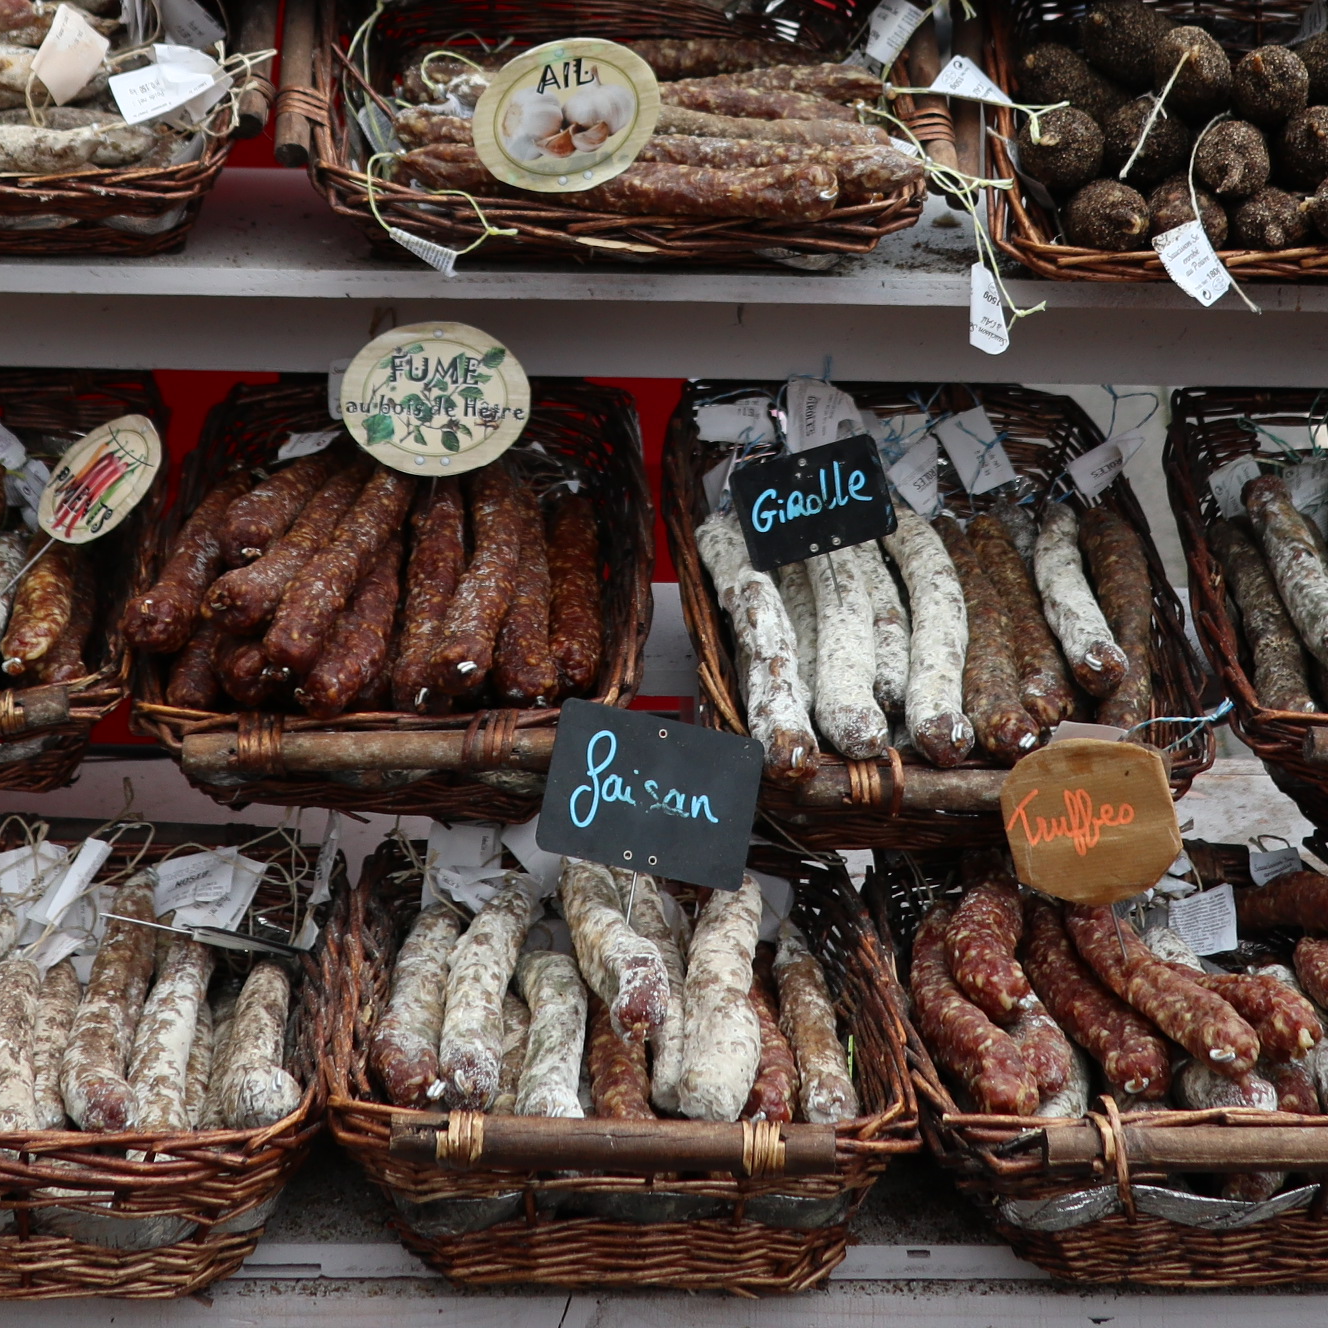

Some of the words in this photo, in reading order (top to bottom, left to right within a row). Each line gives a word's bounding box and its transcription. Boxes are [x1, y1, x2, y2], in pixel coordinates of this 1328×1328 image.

[535, 57, 596, 96] AIL
[389, 352, 483, 387] FUME
[345, 399, 371, 415] au
[431, 395, 454, 418] de
